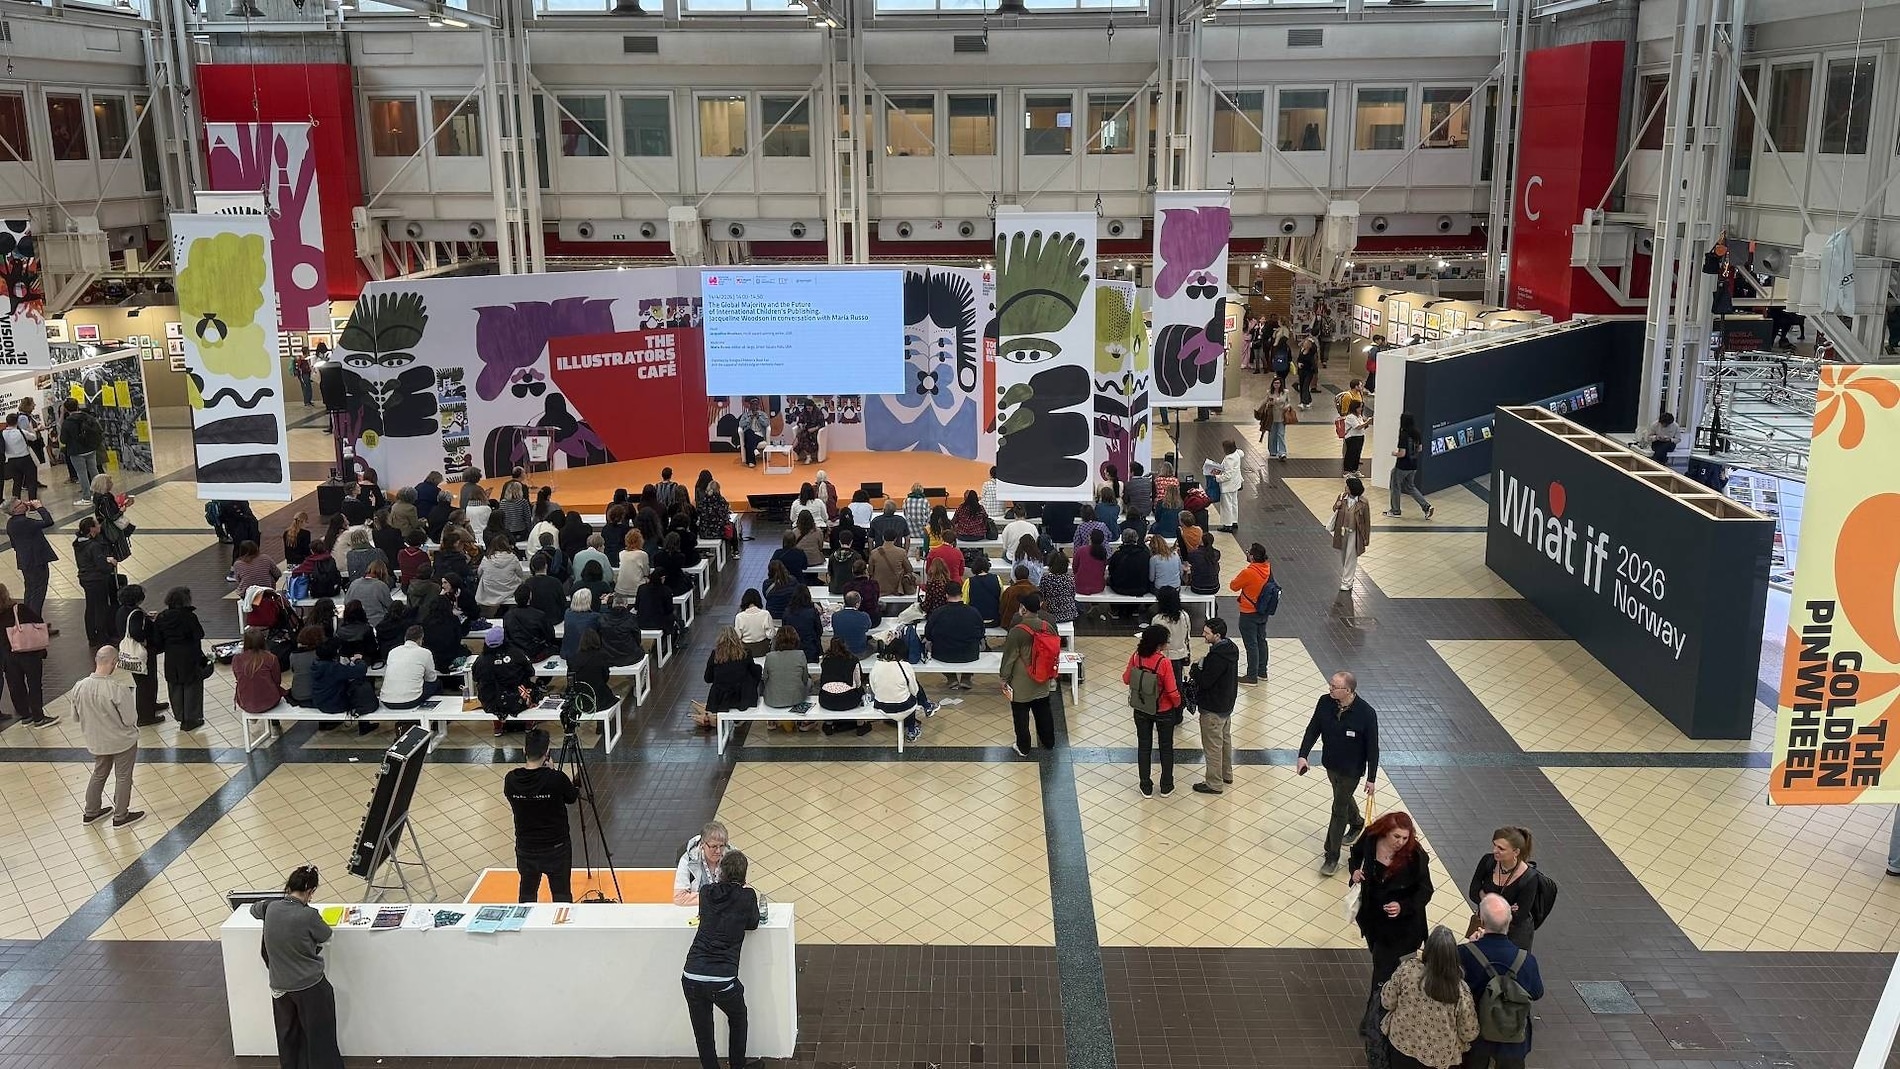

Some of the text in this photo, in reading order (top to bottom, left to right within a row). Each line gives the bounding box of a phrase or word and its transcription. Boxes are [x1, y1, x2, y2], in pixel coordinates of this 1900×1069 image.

[1524, 175, 1543, 221] C
[708, 315, 740, 323] Jacqueline
[741, 301, 767, 309] Majority
[0, 315, 17, 365] VISIONS
[16, 351, 28, 365] 10
[556, 348, 676, 371] ILLUSTRATORS
[645, 333, 676, 349] THE
[637, 361, 677, 380] CAFÉ
[1499, 469, 1610, 595] What if
[1616, 545, 1666, 601] 2026
[1613, 578, 1687, 661] Norway
[1783, 600, 1836, 789] PINWHEEL
[1816, 650, 1863, 787] GOLDEN
[1850, 719, 1888, 787] THE
